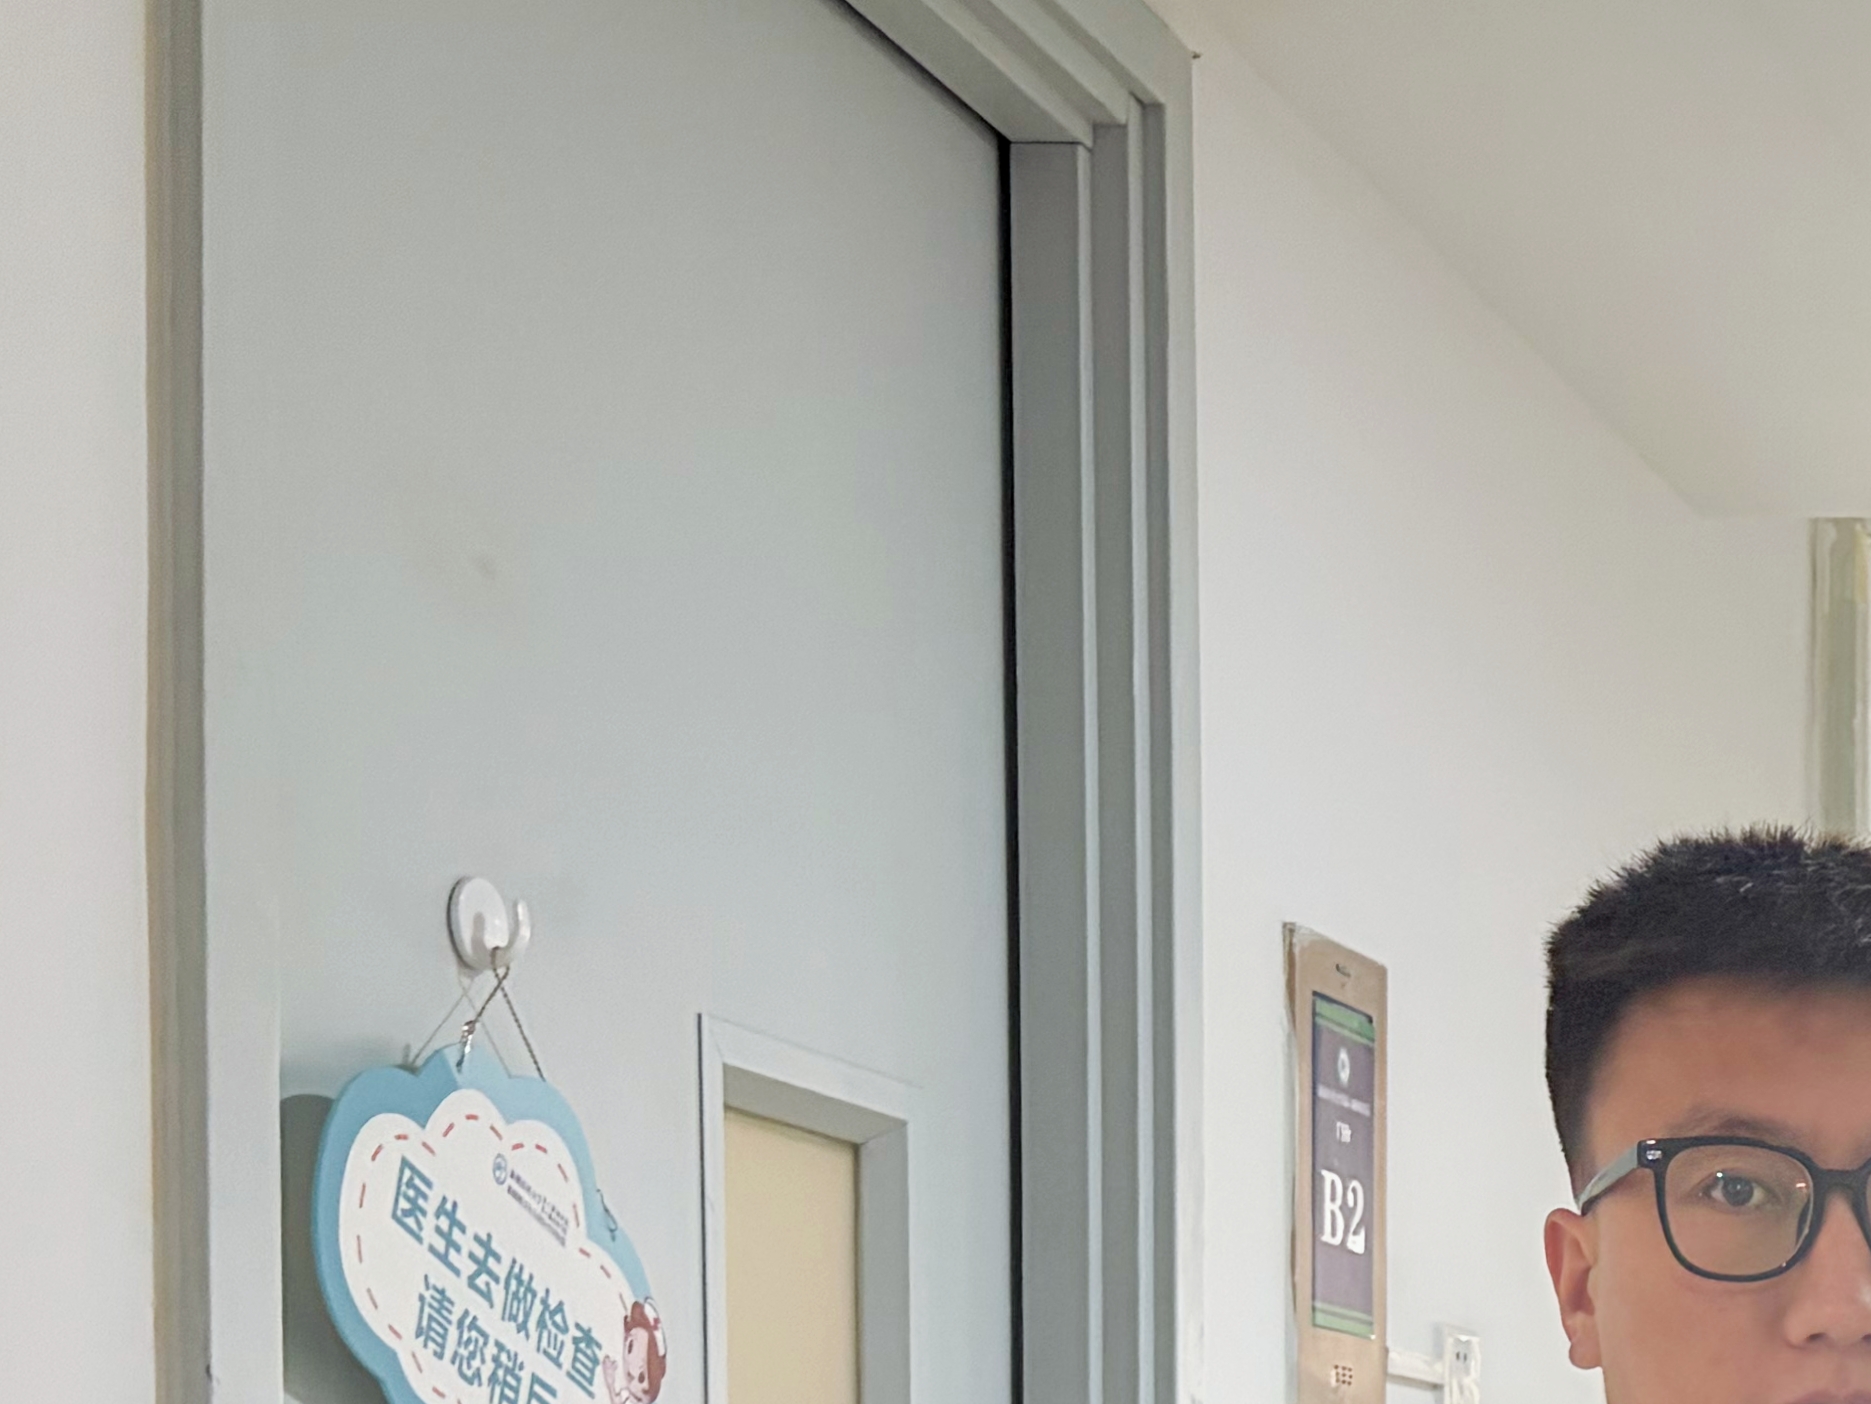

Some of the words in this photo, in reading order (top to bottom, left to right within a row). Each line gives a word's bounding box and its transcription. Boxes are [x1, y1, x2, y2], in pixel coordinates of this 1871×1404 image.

[390, 1156, 604, 1400] 医生去做检查
[1320, 1168, 1366, 1255] B2
